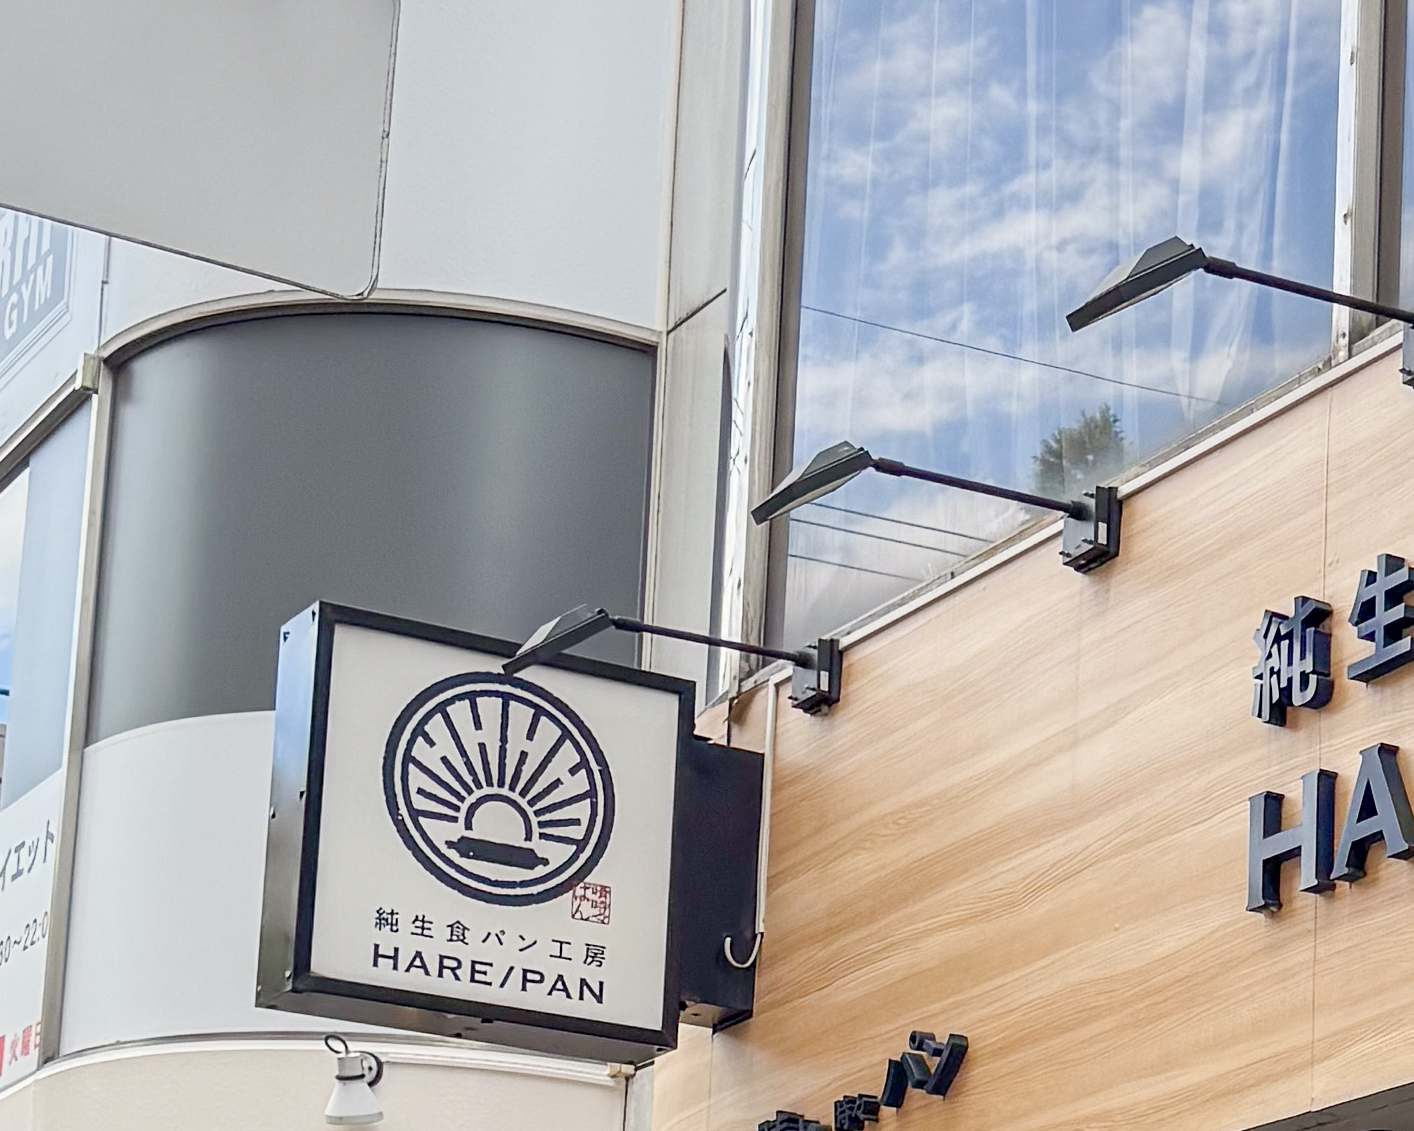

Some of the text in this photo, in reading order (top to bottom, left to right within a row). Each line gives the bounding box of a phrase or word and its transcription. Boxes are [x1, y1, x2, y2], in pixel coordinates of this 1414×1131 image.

[4, 253, 53, 340] GYM
[374, 906, 607, 968] 純生食パン工房
[372, 943, 605, 1004] HARE/PAN
